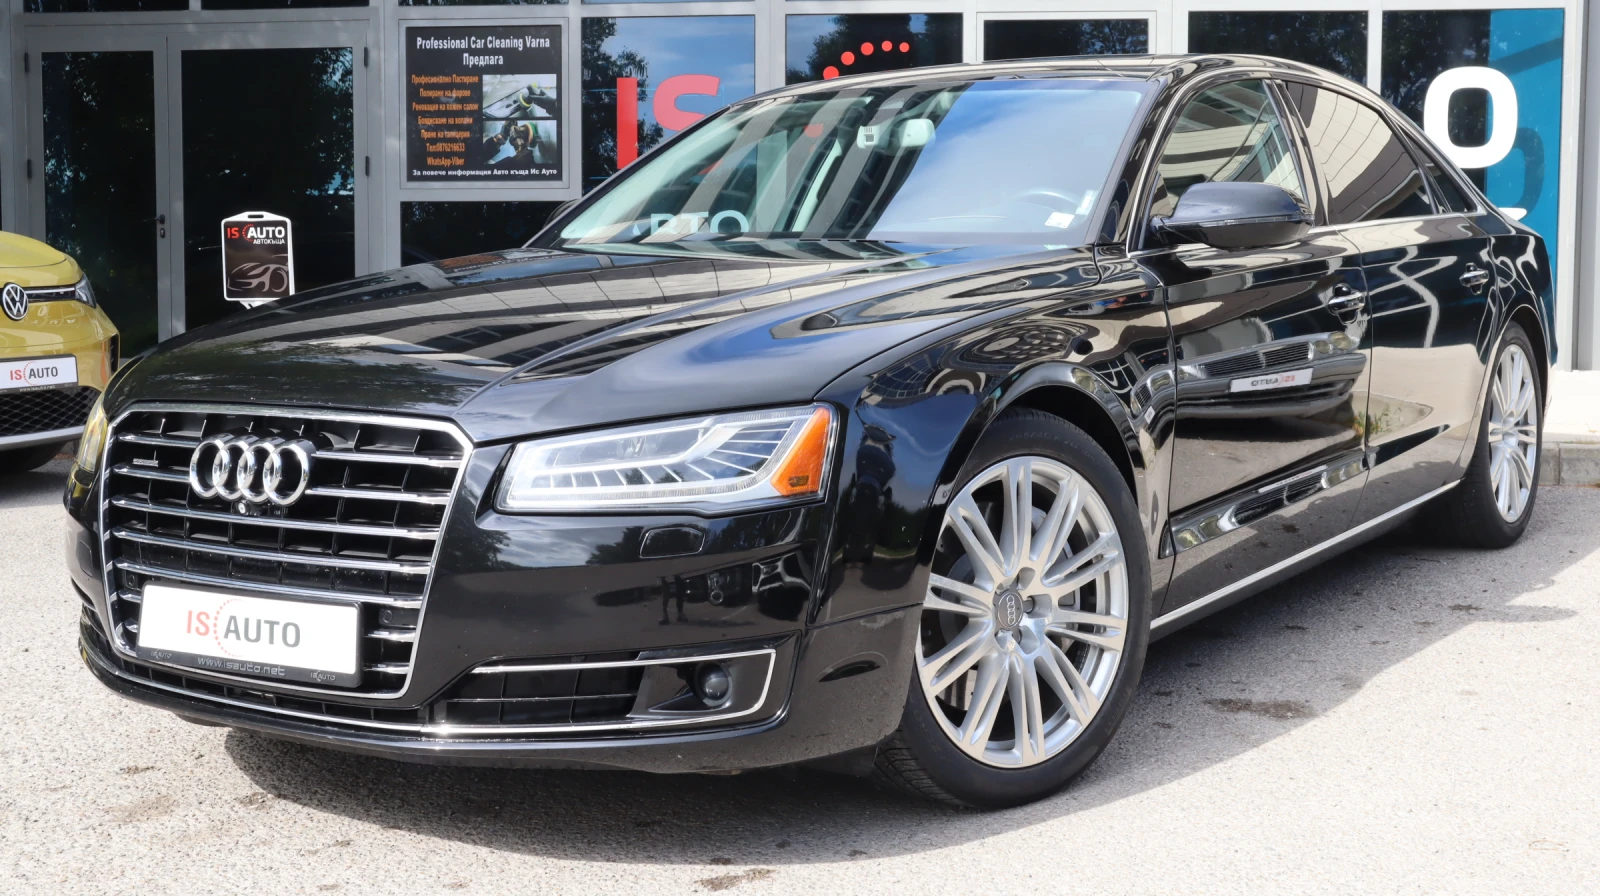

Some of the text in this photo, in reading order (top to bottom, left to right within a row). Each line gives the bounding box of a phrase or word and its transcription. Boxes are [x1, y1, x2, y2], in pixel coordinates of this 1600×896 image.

[416, 36, 550, 51] Professional Car Cleaning Varna
[463, 53, 504, 68] Предлага
[448, 168, 492, 176] информация
[226, 226, 286, 239] IS AUTO
[10, 366, 58, 380] IS AUTO
[186, 610, 300, 648] IS AUTO
[197, 656, 286, 676] www.isauto.net
